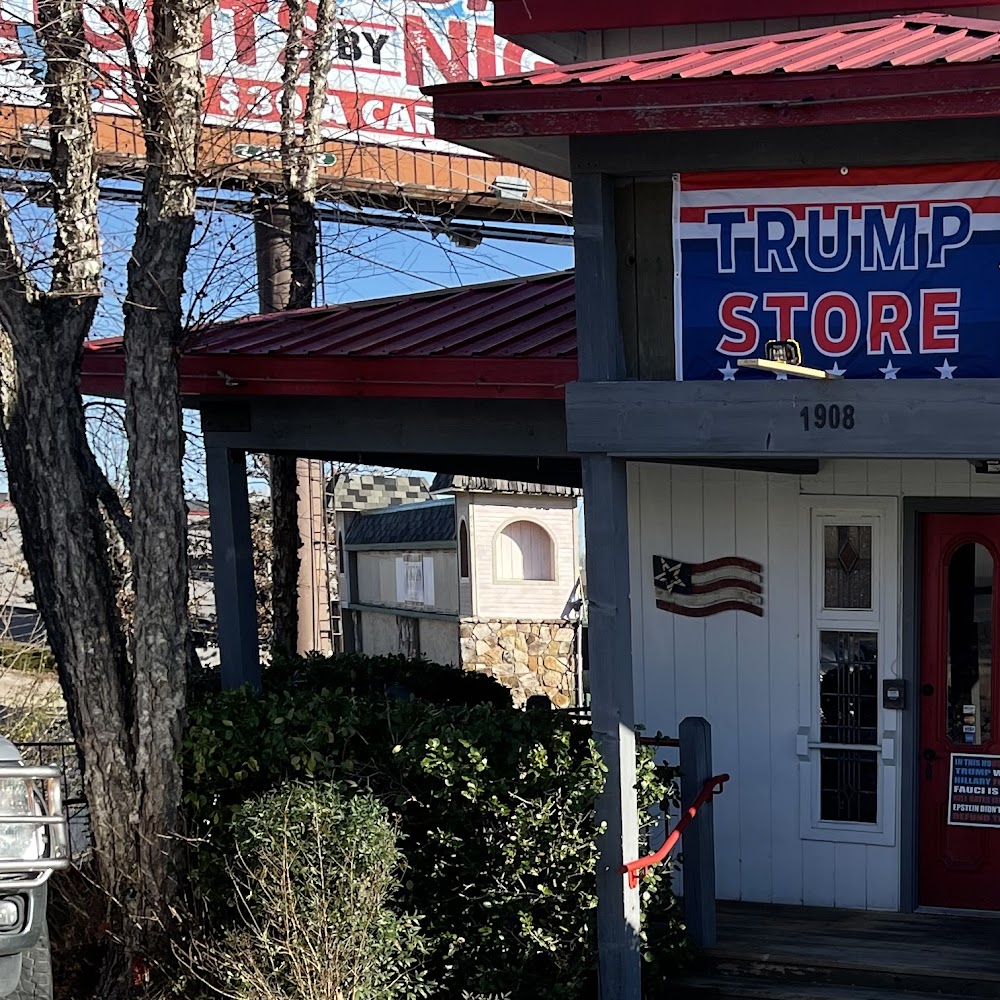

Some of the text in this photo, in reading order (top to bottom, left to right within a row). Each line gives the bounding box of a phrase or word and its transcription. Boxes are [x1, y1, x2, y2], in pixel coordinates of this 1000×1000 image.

[337, 29, 389, 65] BY
[704, 202, 973, 274] TRUMP
[716, 288, 961, 357] STORE
[800, 404, 855, 431] 1908
[954, 758, 963, 766] IN
[964, 758, 981, 767] THIS
[954, 767, 991, 776] TRUMP
[953, 776, 991, 785] HILLARY
[953, 785, 986, 795] FAUCI
[987, 787, 999, 796] IS
[952, 803, 980, 813] EPSTEIN
